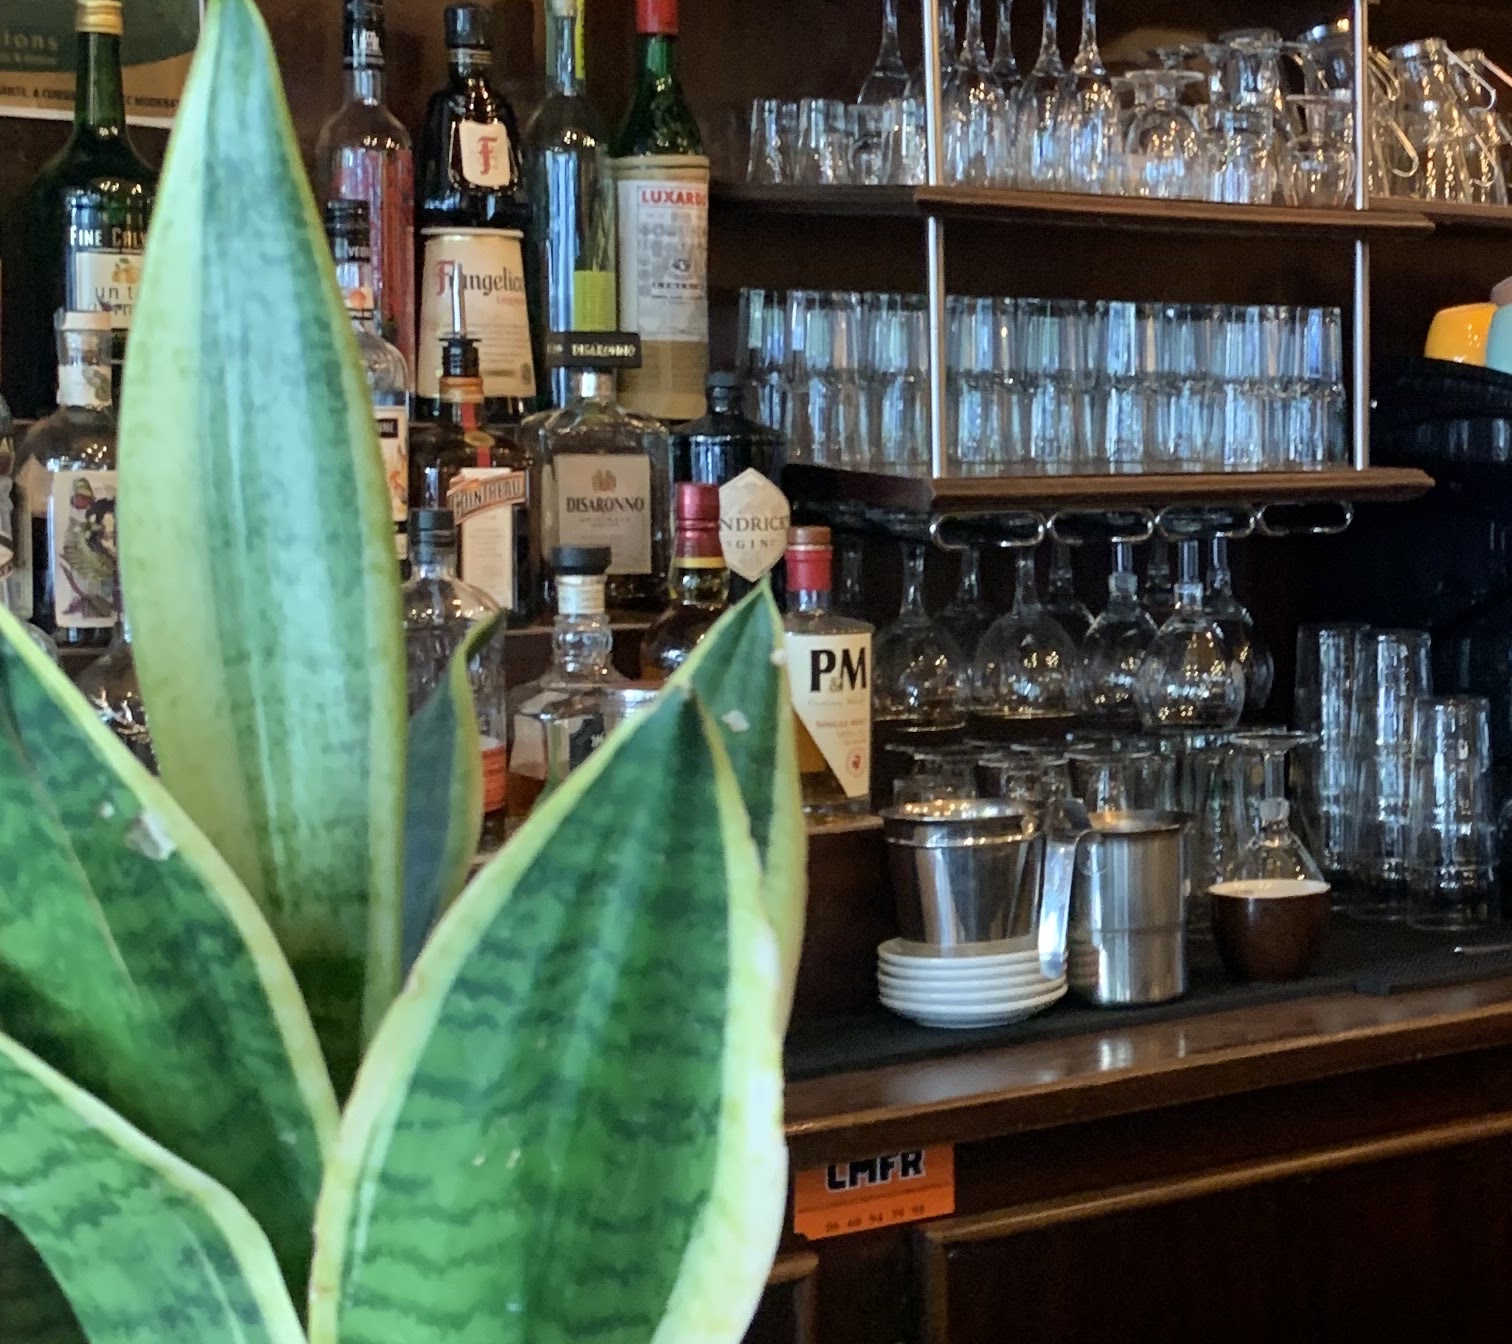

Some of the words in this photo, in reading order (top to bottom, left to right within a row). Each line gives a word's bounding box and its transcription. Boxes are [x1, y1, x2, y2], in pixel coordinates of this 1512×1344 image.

[70, 224, 103, 247] FINE
[566, 496, 645, 514] DISARONNO
[735, 539, 768, 550] GIN
